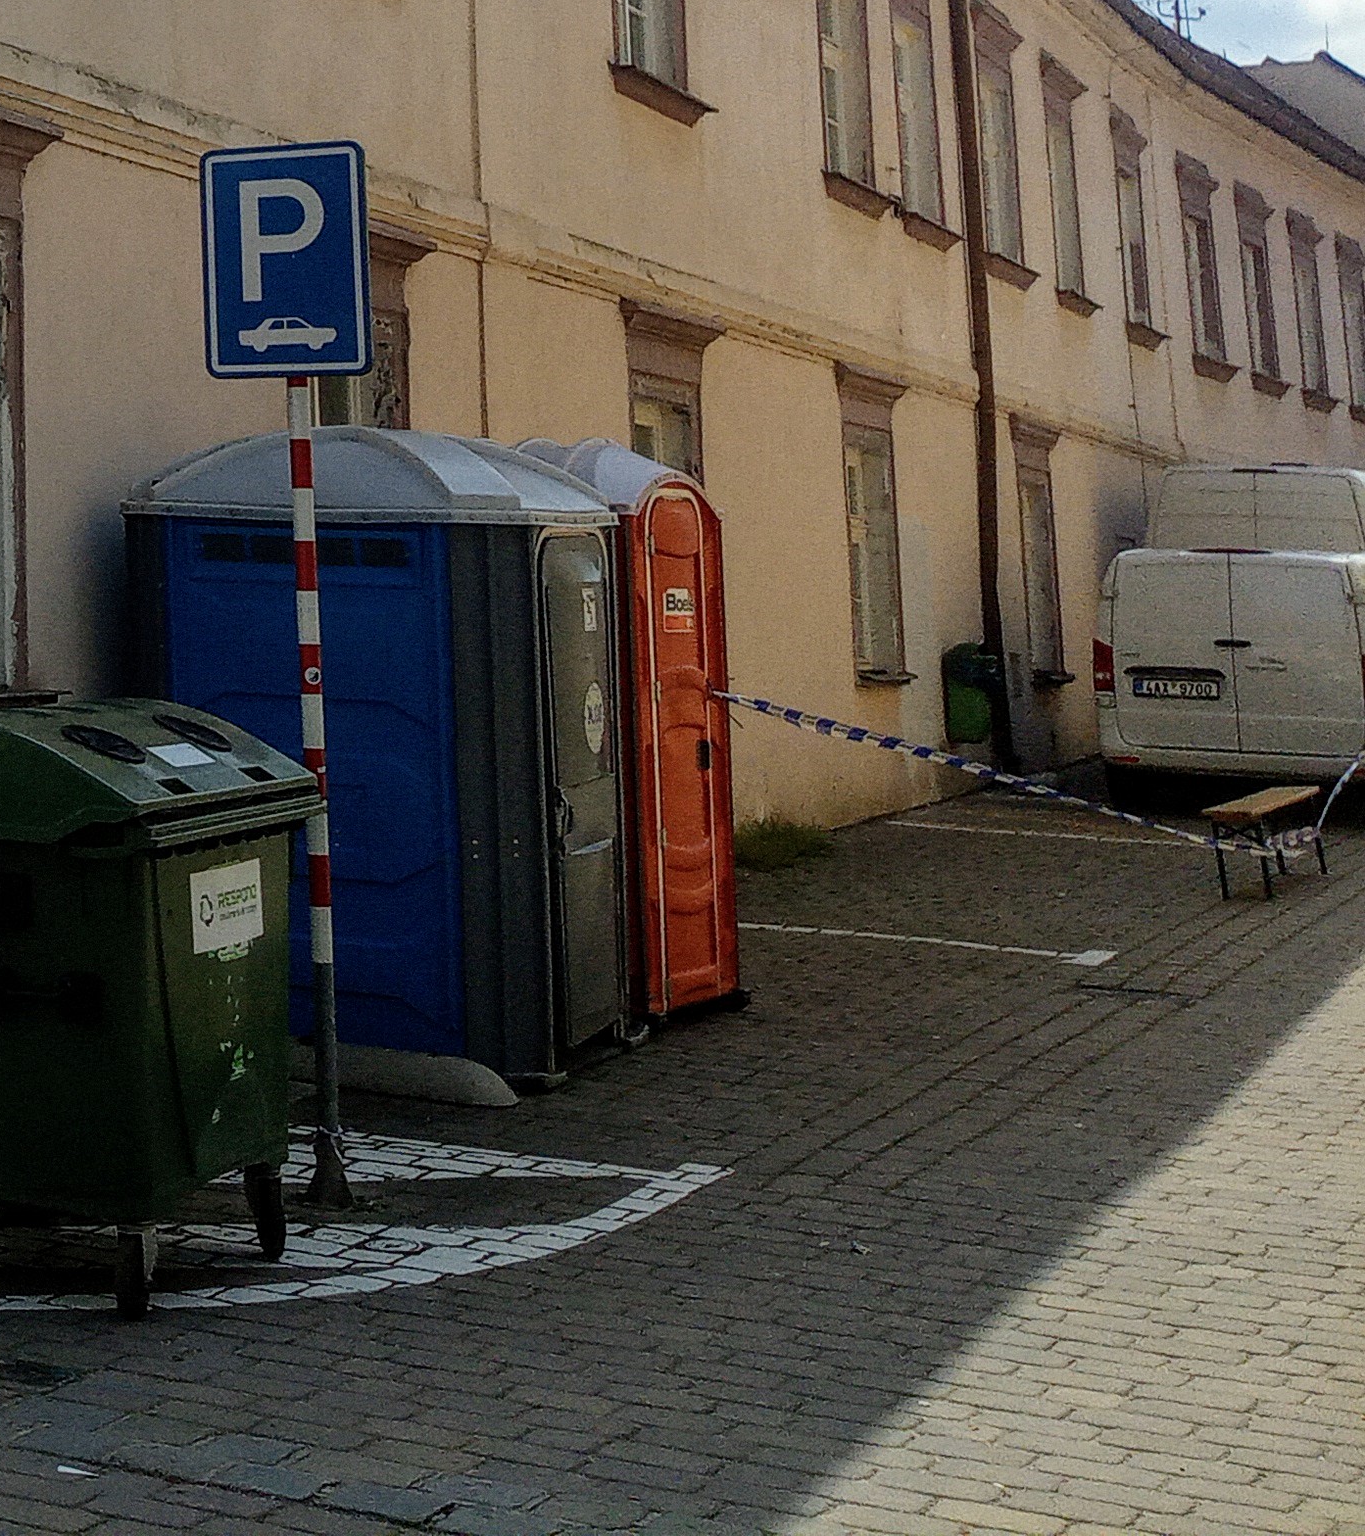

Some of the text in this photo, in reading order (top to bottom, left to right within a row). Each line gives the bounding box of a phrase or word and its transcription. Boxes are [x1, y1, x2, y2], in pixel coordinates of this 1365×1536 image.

[238, 177, 325, 303] P
[1146, 680, 1213, 697] 4AX 9700
